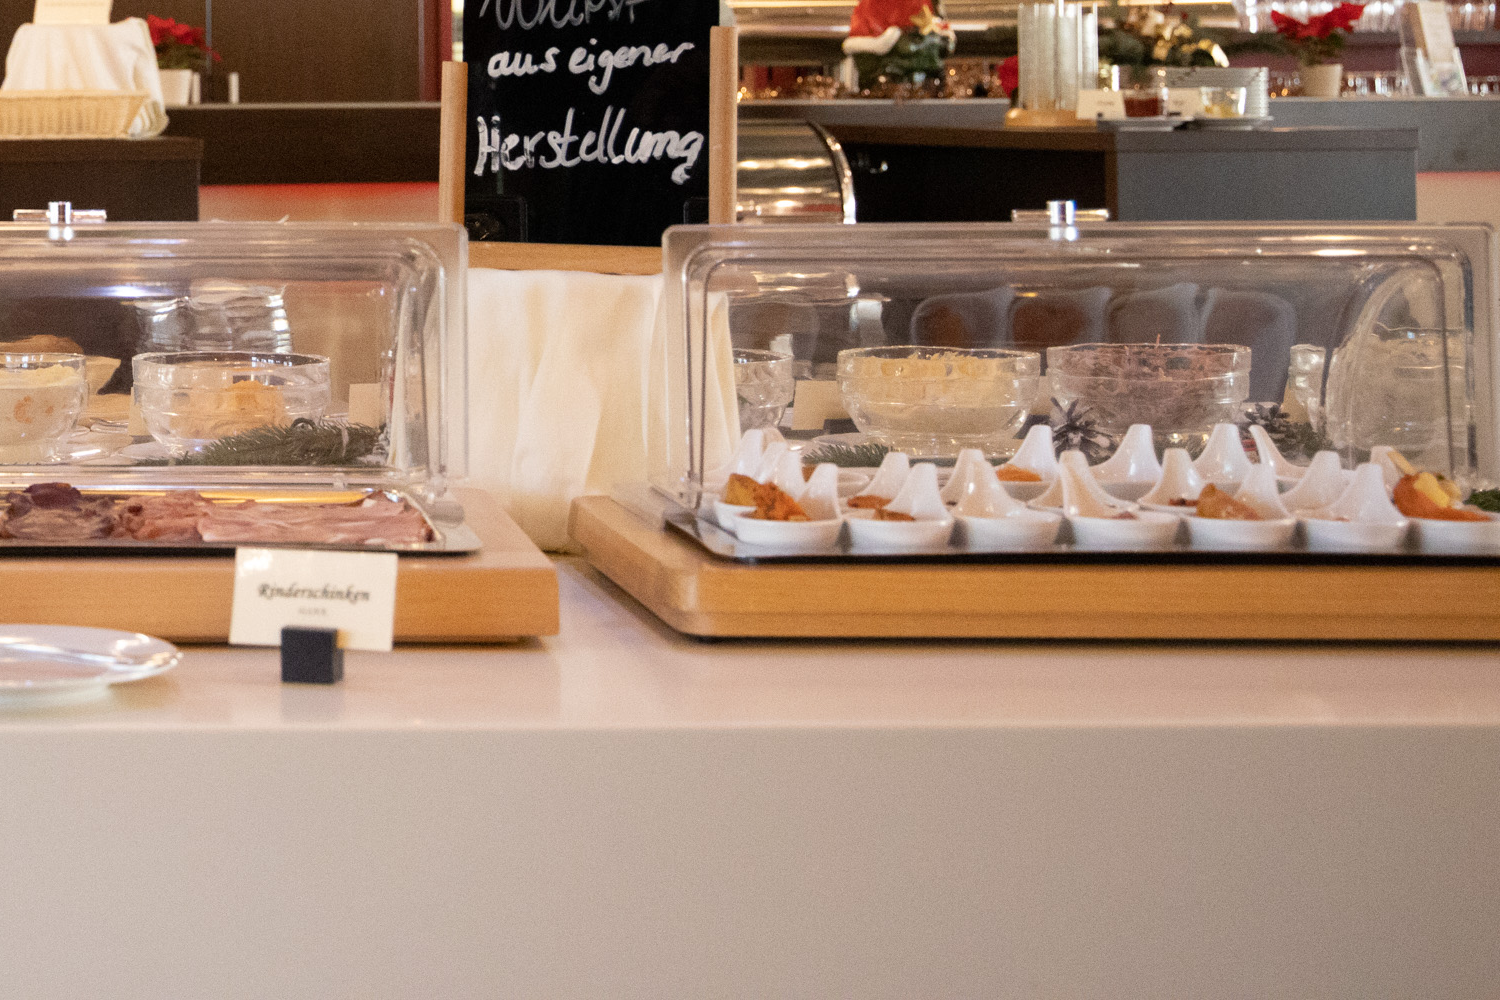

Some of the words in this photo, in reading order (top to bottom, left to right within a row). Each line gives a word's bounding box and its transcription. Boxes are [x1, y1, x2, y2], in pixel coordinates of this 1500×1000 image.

[487, 46, 560, 78] aus
[568, 37, 695, 95] eigener
[473, 105, 705, 185] Herstellung
[258, 581, 370, 604] Rinderschinken
